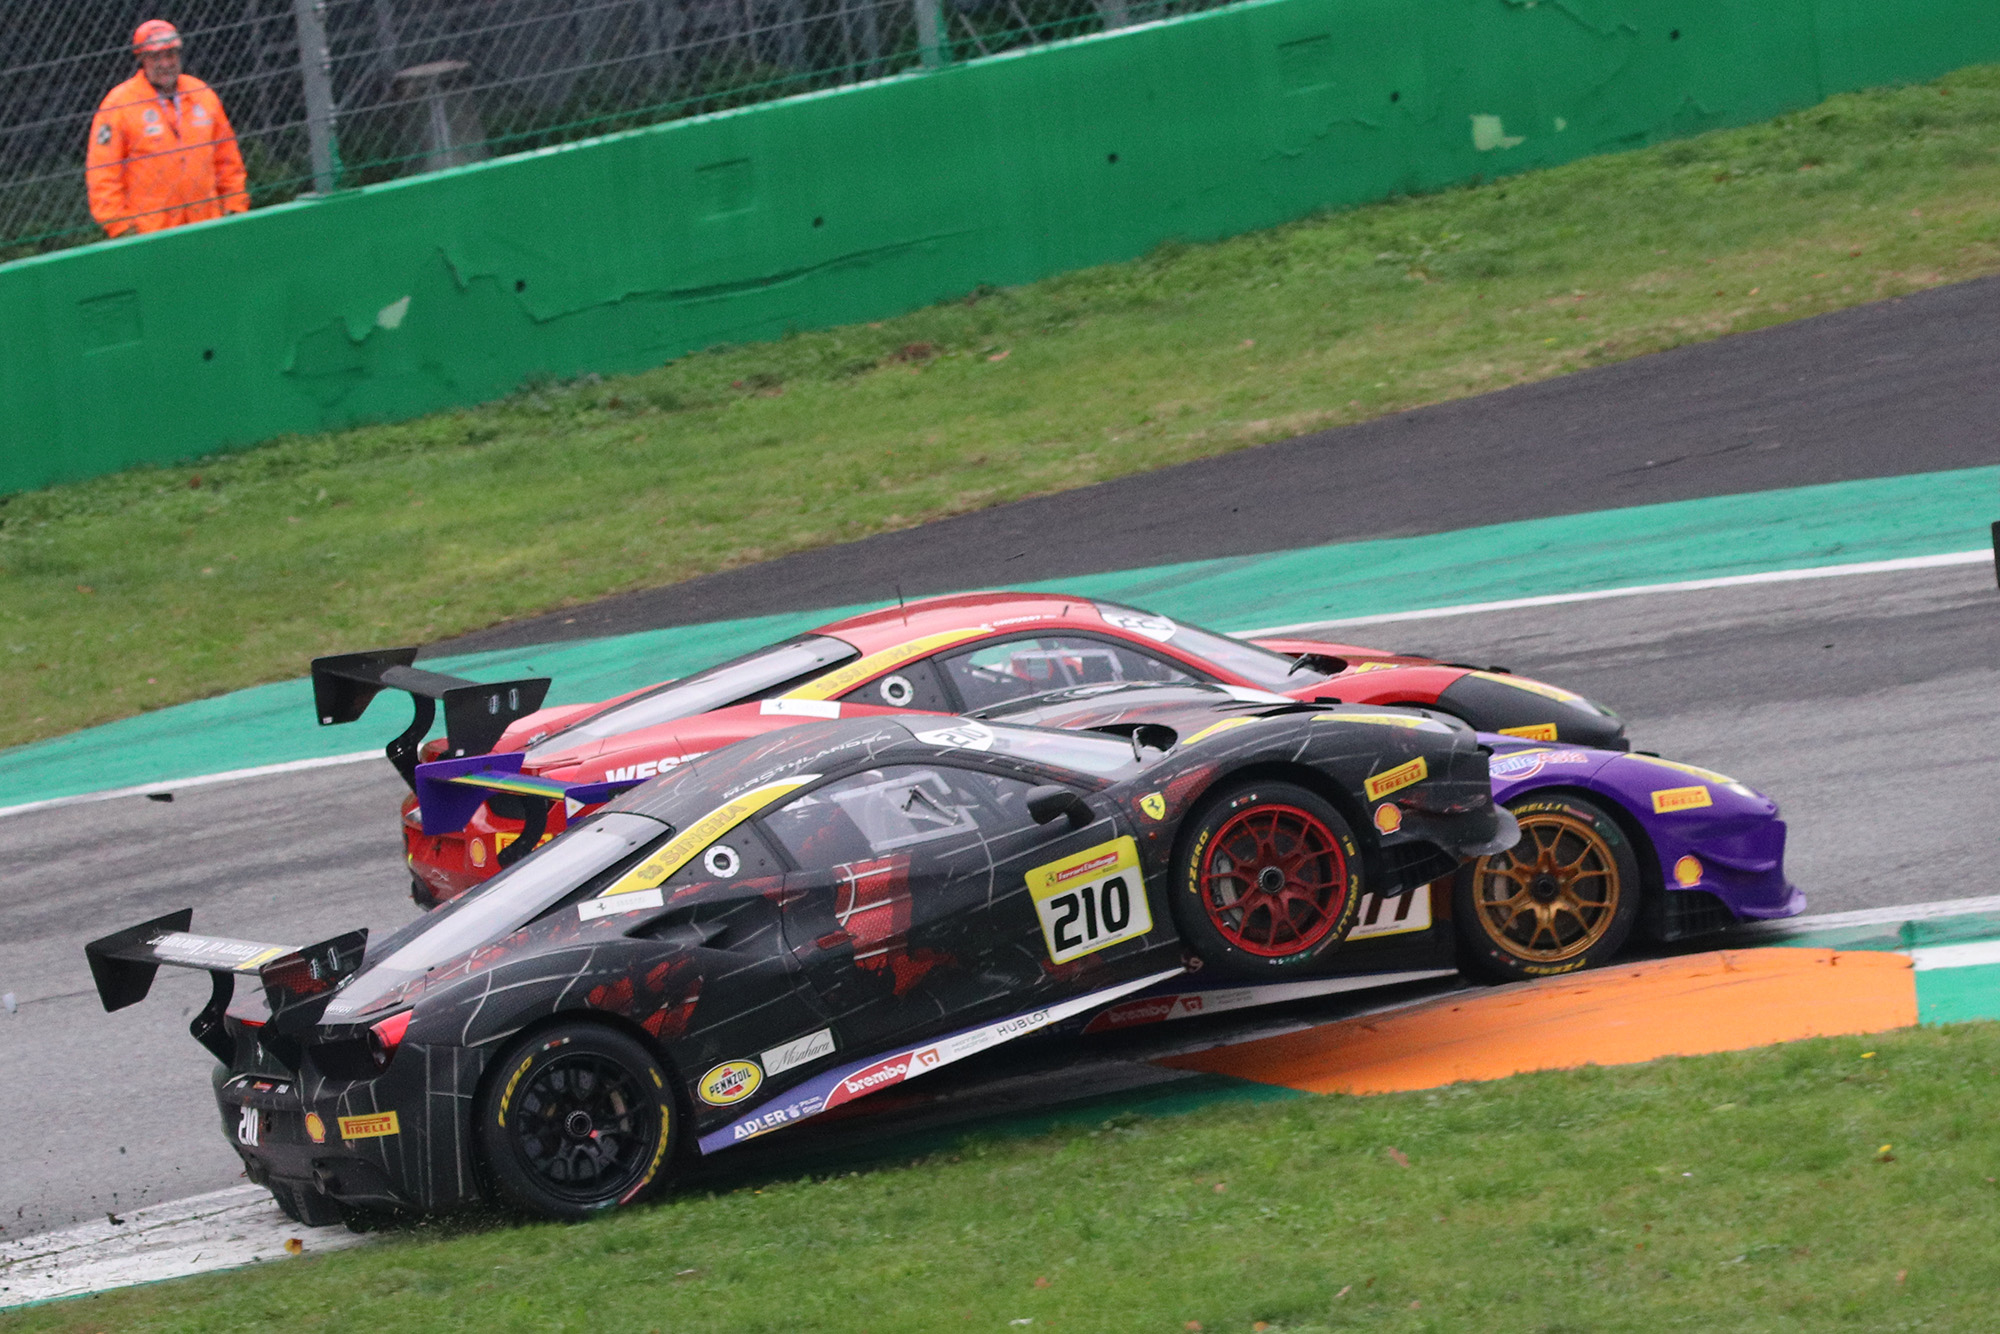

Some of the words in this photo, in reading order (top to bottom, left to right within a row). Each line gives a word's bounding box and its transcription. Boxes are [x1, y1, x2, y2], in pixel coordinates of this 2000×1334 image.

[1372, 763, 1422, 795] PIRELLI
[1658, 791, 1706, 808] PIRELLI
[659, 805, 748, 867] SINGHA
[1050, 876, 1130, 953] 210
[996, 1009, 1050, 1037] HUBLOT
[1109, 1004, 1170, 1023] brembo
[708, 1067, 753, 1098] PENNZOIL
[844, 1063, 907, 1094] brembo
[344, 1116, 392, 1135] PIRELLI
[733, 1109, 789, 1140] ADLER
